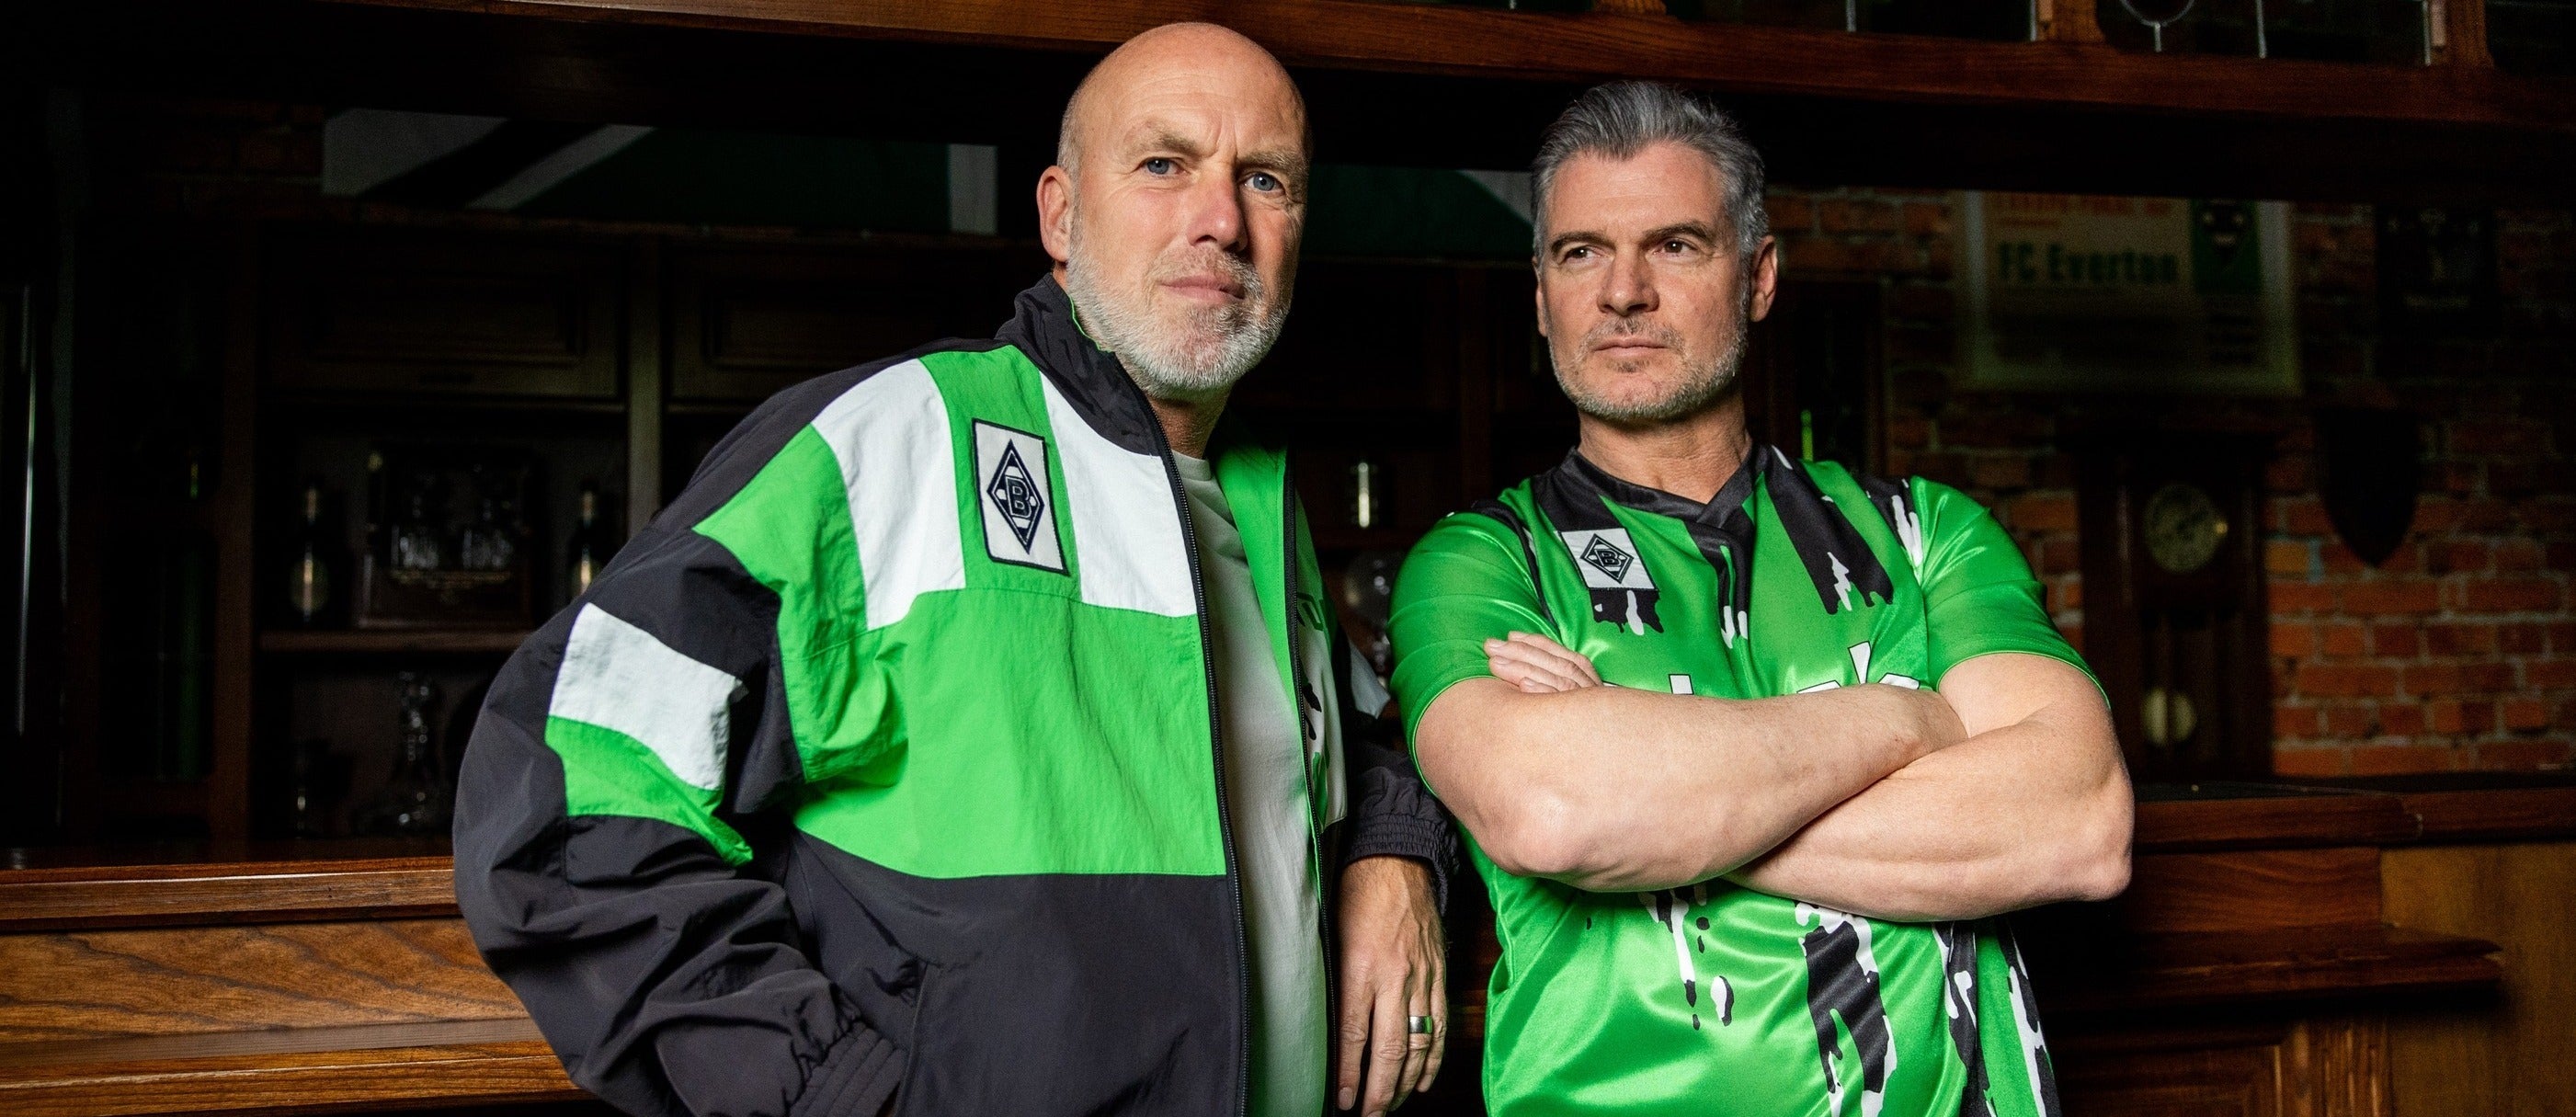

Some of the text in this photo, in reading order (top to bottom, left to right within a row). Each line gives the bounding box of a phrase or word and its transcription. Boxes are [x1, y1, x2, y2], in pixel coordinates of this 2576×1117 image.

[2047, 243, 2178, 283] Everton
[1005, 475, 1032, 519] B
[1594, 548, 1622, 567] B
